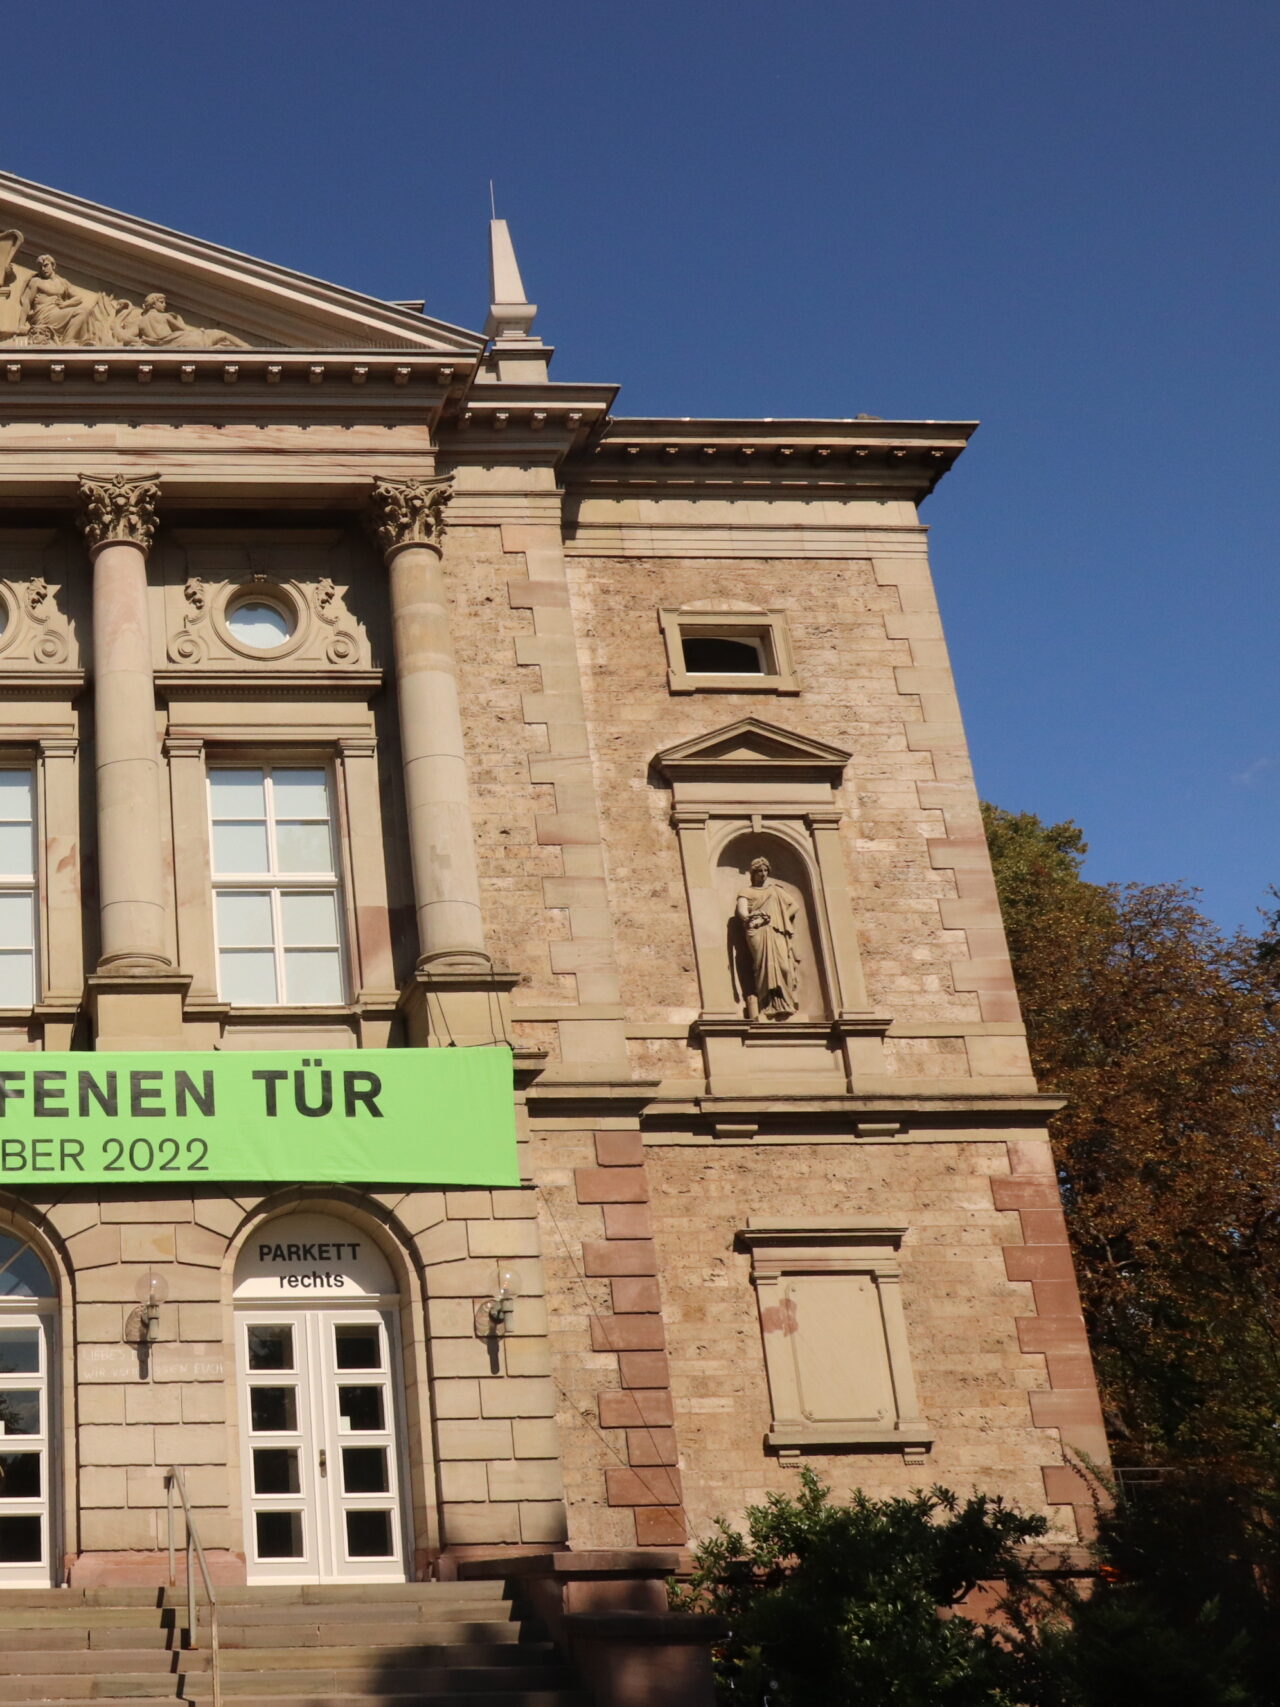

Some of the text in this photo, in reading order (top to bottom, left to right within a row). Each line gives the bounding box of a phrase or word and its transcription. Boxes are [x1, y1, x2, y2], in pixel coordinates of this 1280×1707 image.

[252, 1058, 385, 1118] TÜR
[102, 1137, 210, 1172] 2022
[258, 1242, 361, 1262] PARKETT
[279, 1269, 344, 1288] rechts
